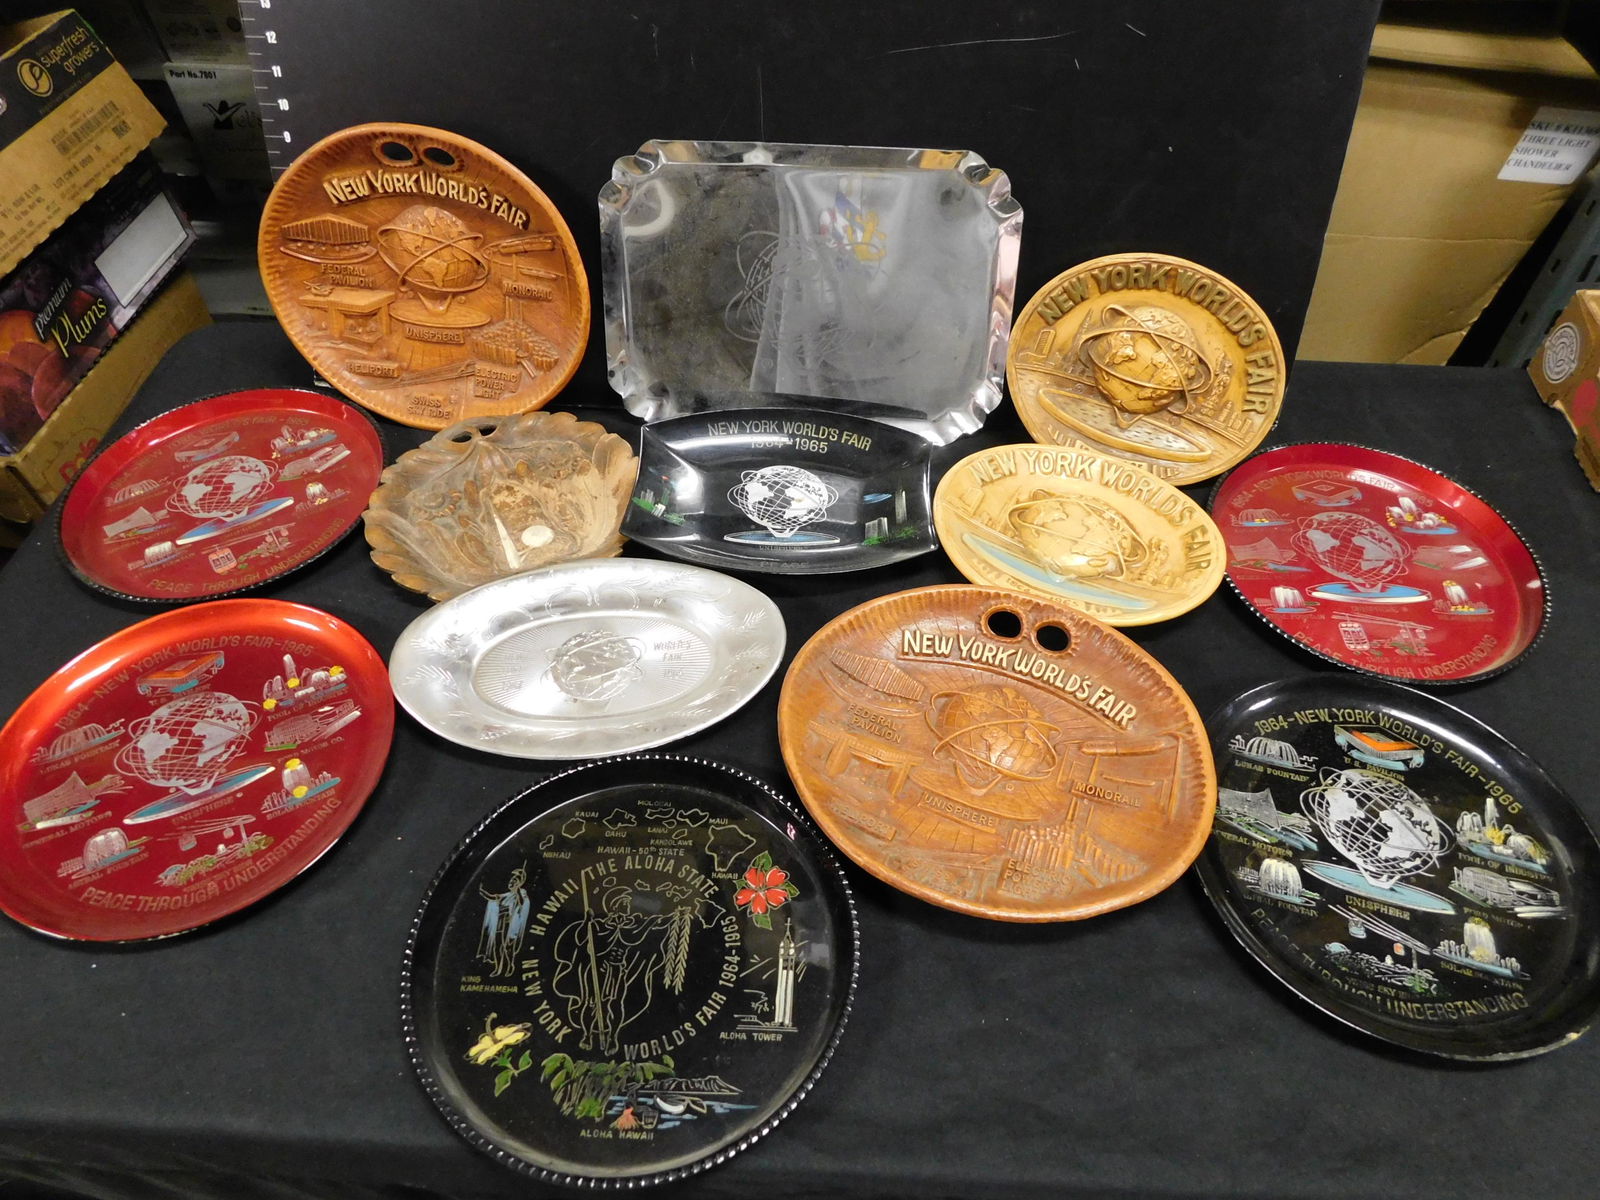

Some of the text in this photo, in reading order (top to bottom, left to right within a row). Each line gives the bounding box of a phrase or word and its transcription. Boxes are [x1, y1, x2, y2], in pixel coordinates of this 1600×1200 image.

[41, 26, 89, 68] superfresh
[265, 31, 277, 44] 12
[63, 42, 100, 76] growers
[271, 65, 282, 77] 11
[169, 70, 186, 78] Part
[277, 98, 289, 111] 10
[283, 130, 292, 143] 9
[1522, 135, 1591, 148] THREE LIGHT
[1515, 146, 1559, 158] SHOWER
[323, 169, 529, 231] NEW YORK WORLD'S FAIR
[321, 263, 366, 277] FEDERAL
[329, 273, 374, 288] PAVILION
[503, 282, 553, 300] MONORAIL
[34, 277, 72, 340] premium
[51, 297, 107, 359] Plums
[405, 327, 461, 343] UNISPHERE
[1036, 263, 1276, 415] NEW YORK WORLD'S FAIR
[708, 420, 872, 451] NEW YORK WORLD'S FAIR
[969, 450, 1212, 572] NEW YORK WORLD'S FAIR
[148, 578, 194, 594] PEACE
[201, 572, 260, 591] THROUGH
[263, 517, 345, 580] UNDERSTANDING
[130, 646, 175, 674] YORK
[176, 634, 242, 655] WORLD'S
[1418, 634, 1498, 679] UNDERSTANDING
[902, 629, 1138, 731] NEW YORK WORLD'S FAIR
[847, 702, 898, 732] FEDERAL
[851, 716, 902, 745] PAVILION
[1331, 707, 1377, 725] YORK
[1378, 712, 1444, 754] WORLD'S
[1366, 764, 1406, 782] PAVILION
[1075, 781, 1142, 808] MONORAIL
[575, 810, 599, 818] KAUAI
[924, 791, 995, 828] UNISPHERE
[604, 830, 627, 838] OAHU
[79, 886, 137, 913] PEACE
[222, 798, 343, 892] UNDERSTANDING
[597, 846, 631, 855] HAWAII
[658, 847, 686, 857] STATE
[711, 872, 739, 880] HAWAII
[529, 855, 720, 936] HAWAII THE ALOHA STATE
[1344, 894, 1412, 921] UNISPHERE
[460, 985, 519, 994] KAMEHAMEHA
[461, 975, 482, 983] KING
[521, 914, 742, 1061] NEW YORK WORLD'S FAIR 1964-1965
[719, 1031, 784, 1042] ALOHA TOWER
[579, 1129, 655, 1141] ALOHA HAWAII
